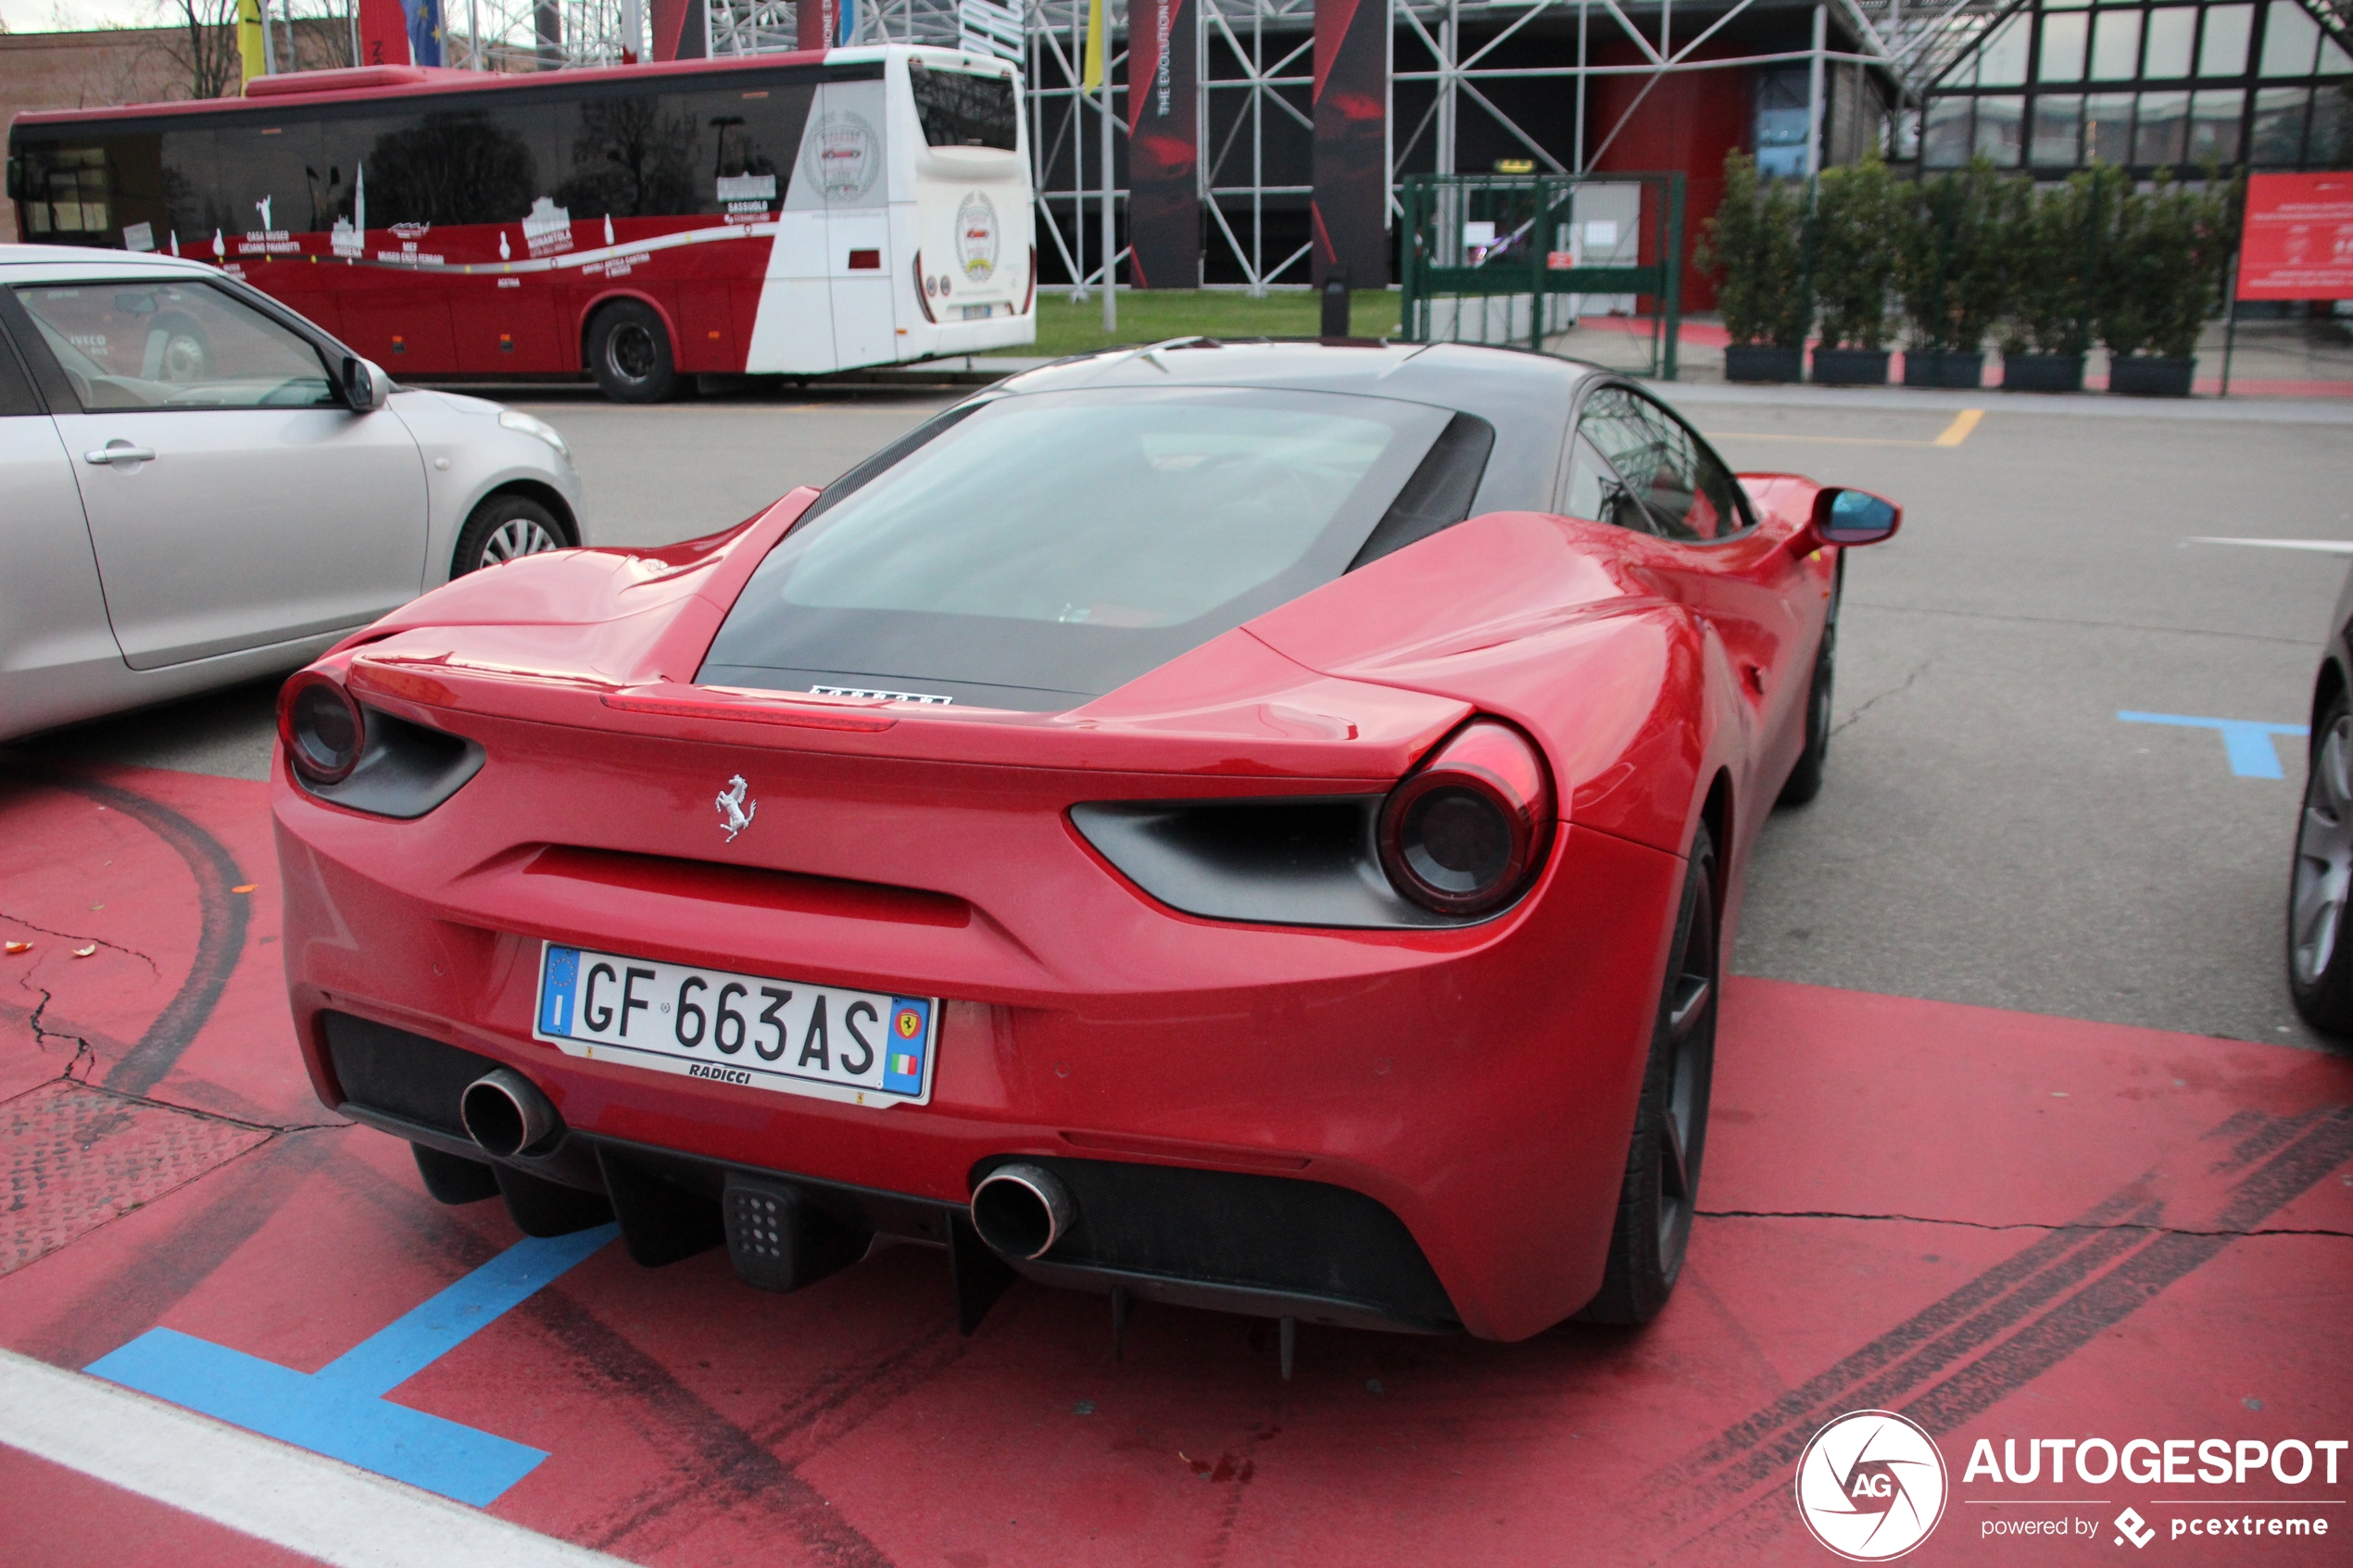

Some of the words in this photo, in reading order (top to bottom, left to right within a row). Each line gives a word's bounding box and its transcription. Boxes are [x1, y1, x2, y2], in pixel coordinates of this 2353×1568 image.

[1158, 5, 1170, 83] EVOLUTION
[1158, 86, 1170, 116] THE
[727, 200, 769, 213] SASSUOLO
[246, 231, 265, 242] CASA
[265, 230, 290, 242] MUSEO
[527, 229, 573, 249] NONANTOLA
[238, 242, 266, 254] LUCIANO
[266, 241, 301, 254] PAVAROTTI
[333, 245, 363, 258] MODENA
[402, 241, 419, 253] MEF
[378, 251, 401, 263] MUSEO
[401, 252, 418, 264] ENZO
[418, 253, 445, 264] FERRARI
[70, 334, 107, 346] IVECO
[688, 1063, 750, 1085] RADICCI
